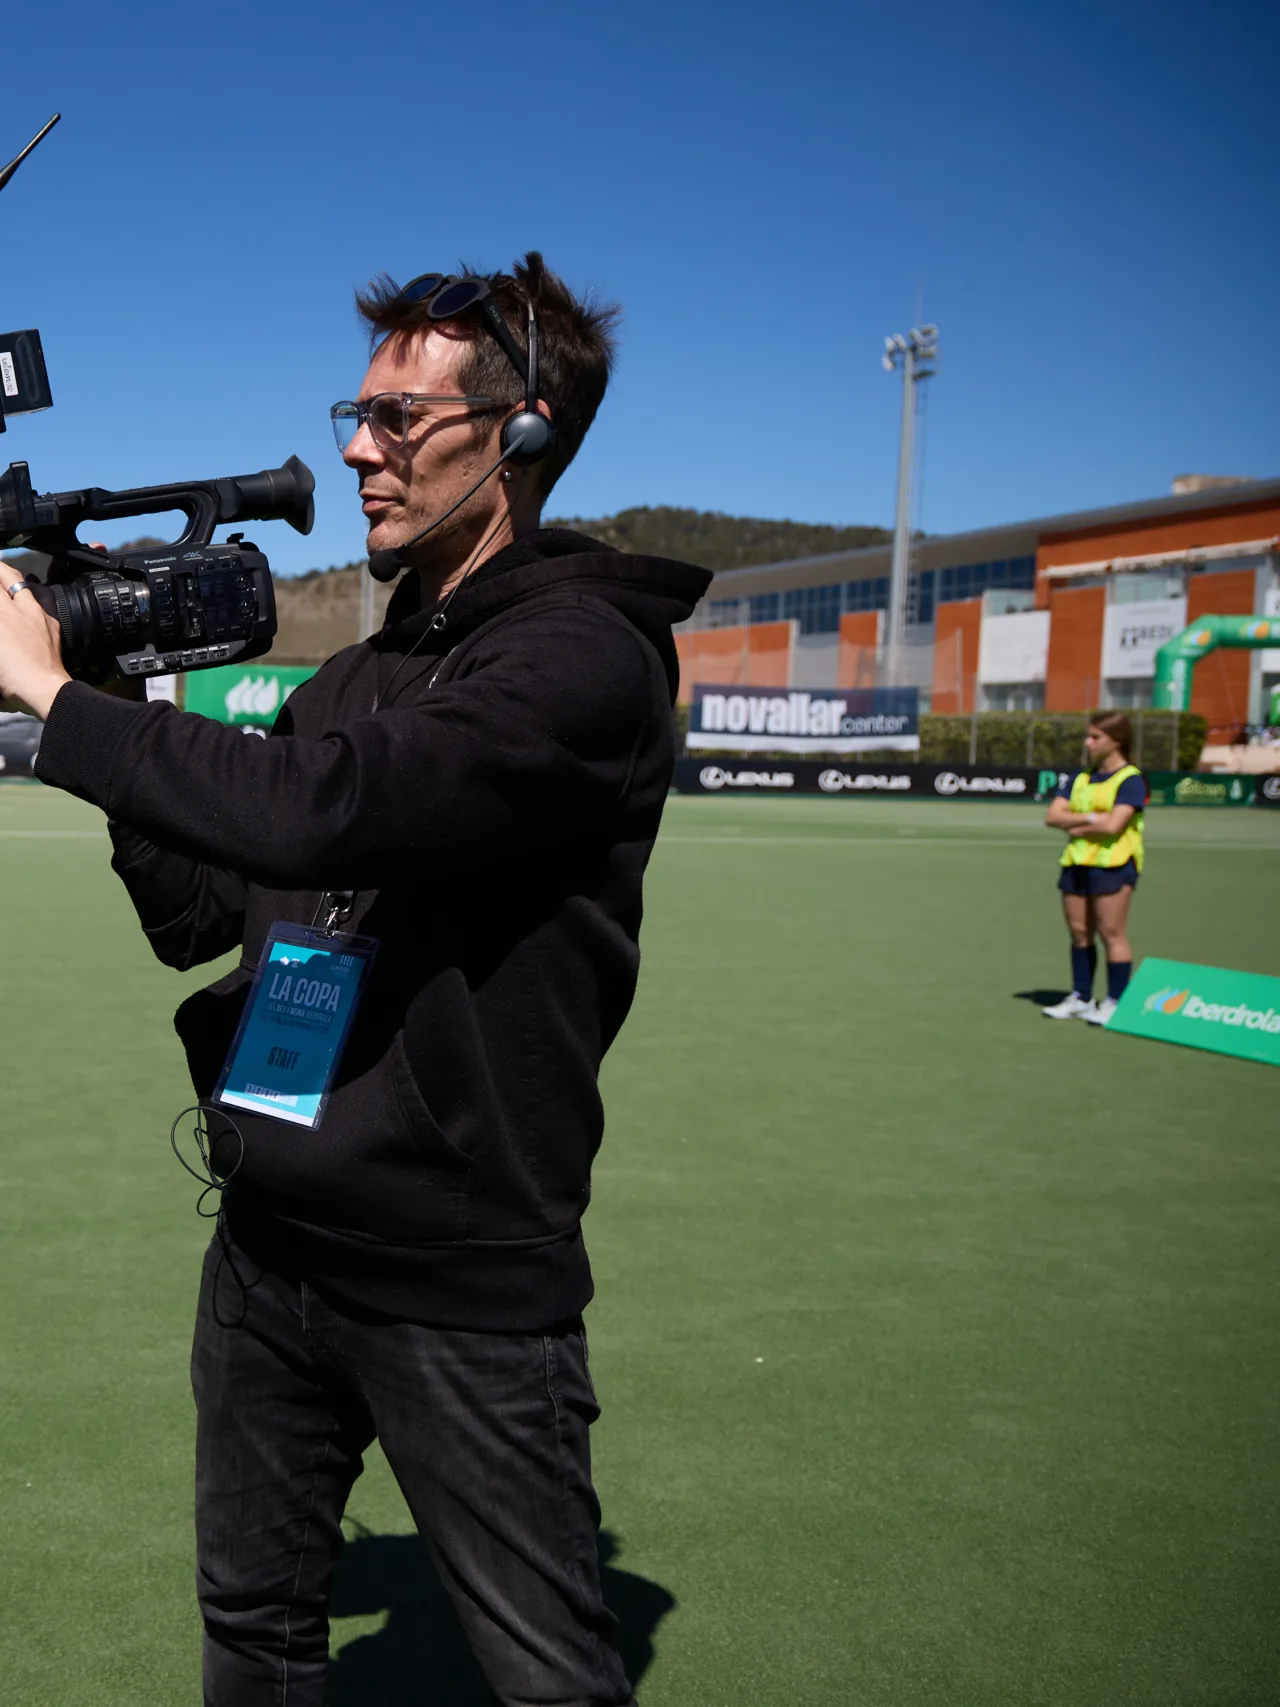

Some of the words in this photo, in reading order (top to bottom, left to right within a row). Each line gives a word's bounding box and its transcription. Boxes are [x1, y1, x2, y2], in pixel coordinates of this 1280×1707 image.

[144, 556, 177, 565] Panasonic
[701, 692, 847, 735] novallar
[841, 713, 908, 735] center
[725, 770, 795, 788] LEXUS
[843, 774, 912, 791] LEXUS
[959, 776, 1026, 793] LEXUS
[269, 973, 292, 1001] LA
[293, 978, 340, 1012] COPA
[268, 1047, 301, 1070] STAFF
